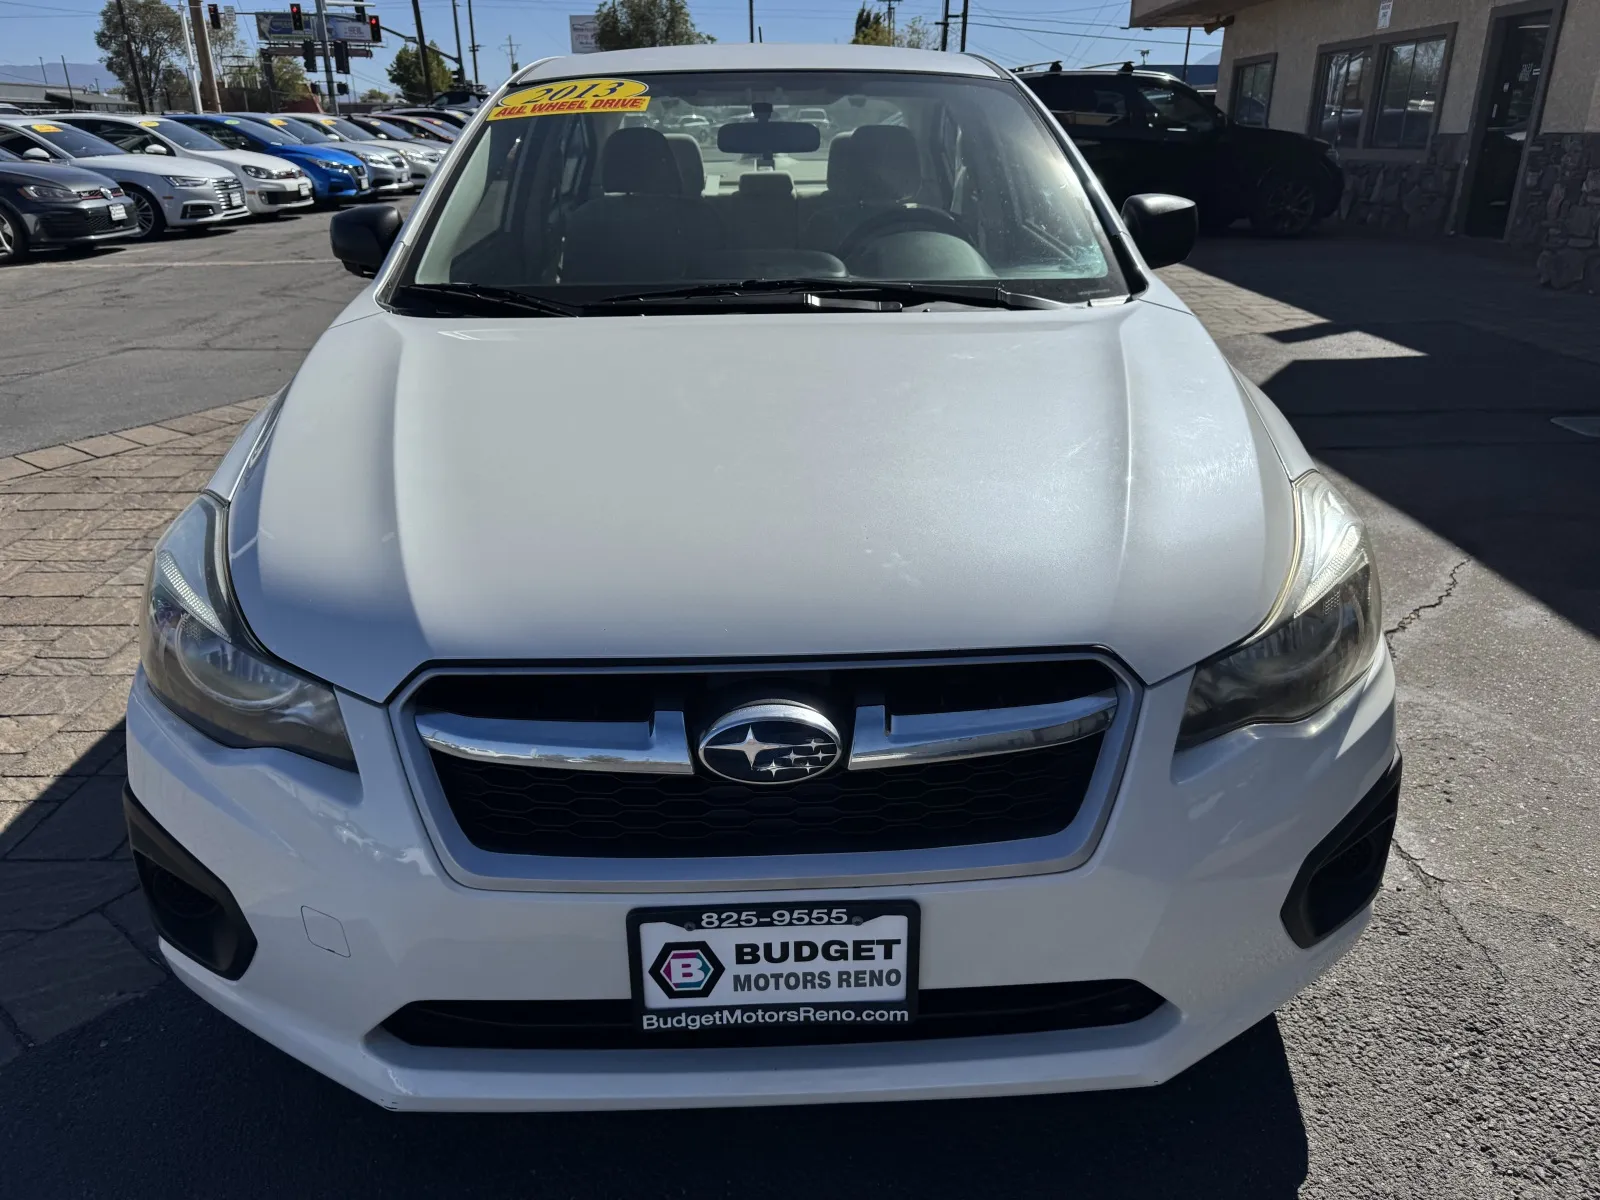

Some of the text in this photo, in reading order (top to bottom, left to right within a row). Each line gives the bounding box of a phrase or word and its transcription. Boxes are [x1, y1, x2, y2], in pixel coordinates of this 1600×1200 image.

[523, 81, 624, 103] 2013
[494, 97, 642, 117] ALL WHEEL DRIVE
[700, 908, 848, 928] 825-9555
[735, 939, 902, 965] BUDGET
[669, 957, 706, 984] B
[733, 969, 902, 992] MOTORS RENO
[642, 1006, 909, 1030] BudgetMotorsReno.com
